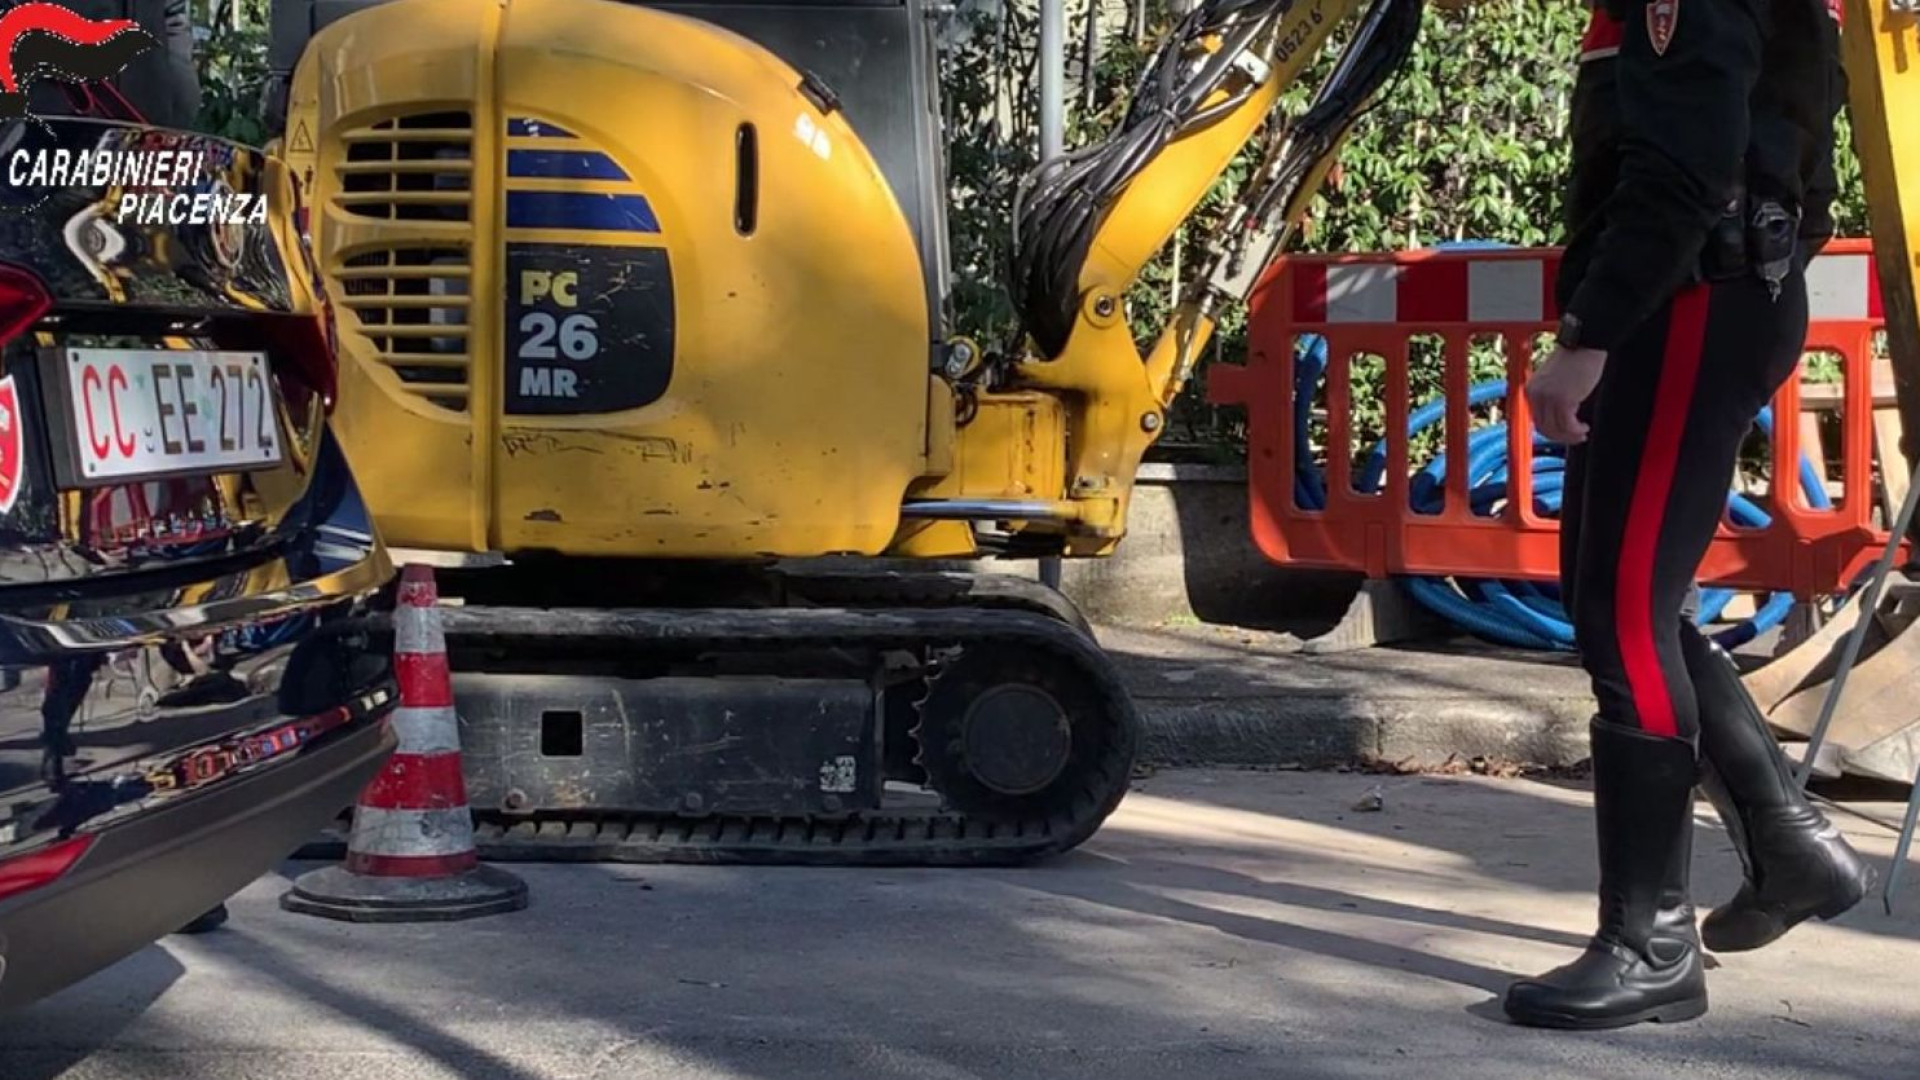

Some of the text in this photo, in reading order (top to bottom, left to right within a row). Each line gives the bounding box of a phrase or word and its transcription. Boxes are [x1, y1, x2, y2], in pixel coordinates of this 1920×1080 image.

[1274, 18, 1312, 63] 0523
[520, 270, 578, 307] PC
[518, 312, 599, 361] 26
[519, 367, 578, 397] MR
[82, 364, 272, 459] CC EE 272
